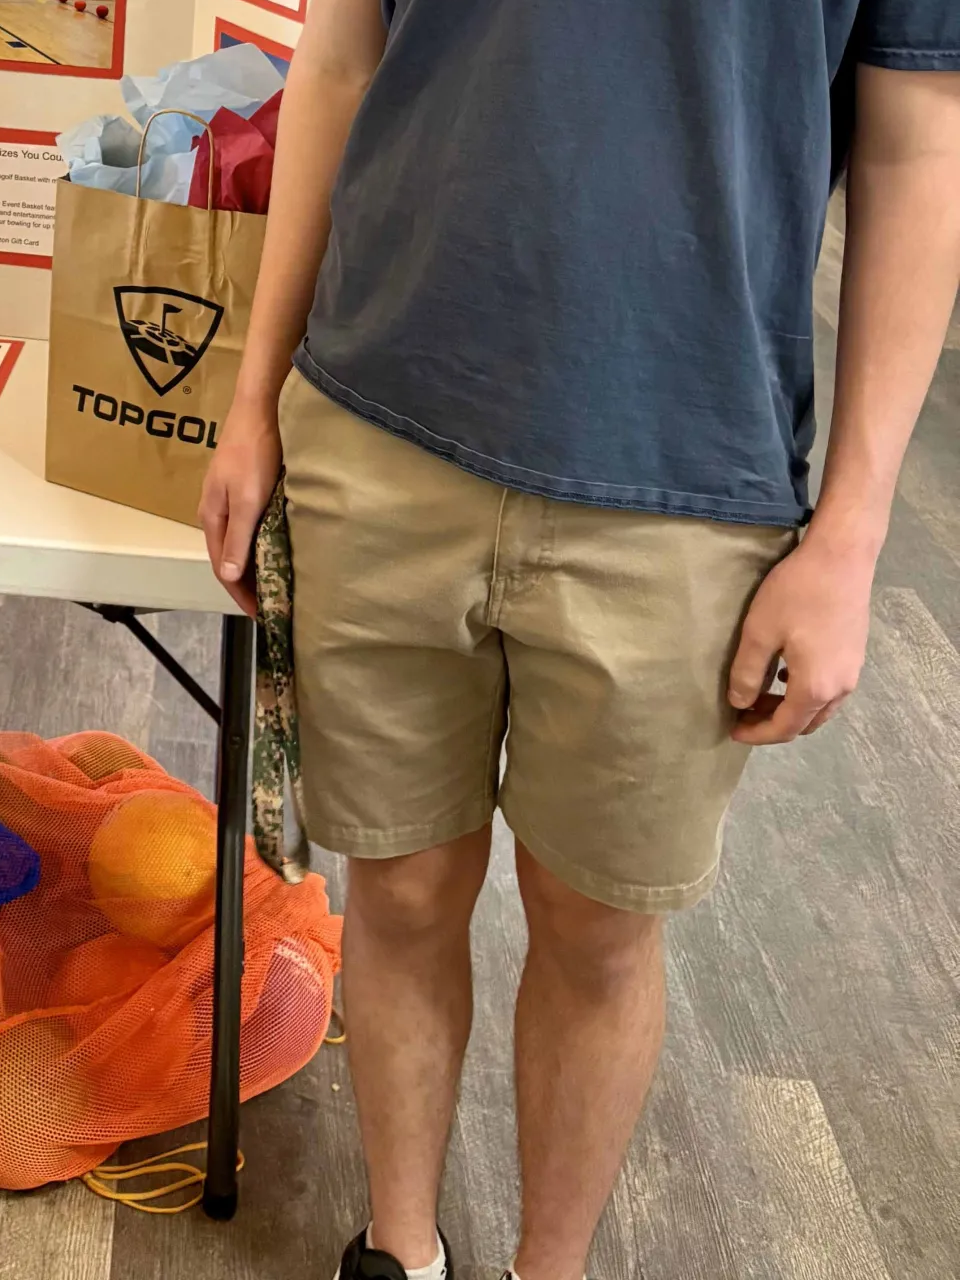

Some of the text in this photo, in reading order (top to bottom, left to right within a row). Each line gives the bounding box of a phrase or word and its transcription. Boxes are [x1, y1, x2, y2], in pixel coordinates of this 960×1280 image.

[21, 149, 40, 160] You
[42, 151, 64, 162] Cou
[14, 173, 36, 182] Basket
[1, 200, 21, 208] Event
[21, 201, 44, 210] Basket
[6, 219, 31, 228] bowling
[10, 237, 23, 245] Gift
[23, 238, 39, 246] Card
[72, 384, 218, 449] TOPGOL
